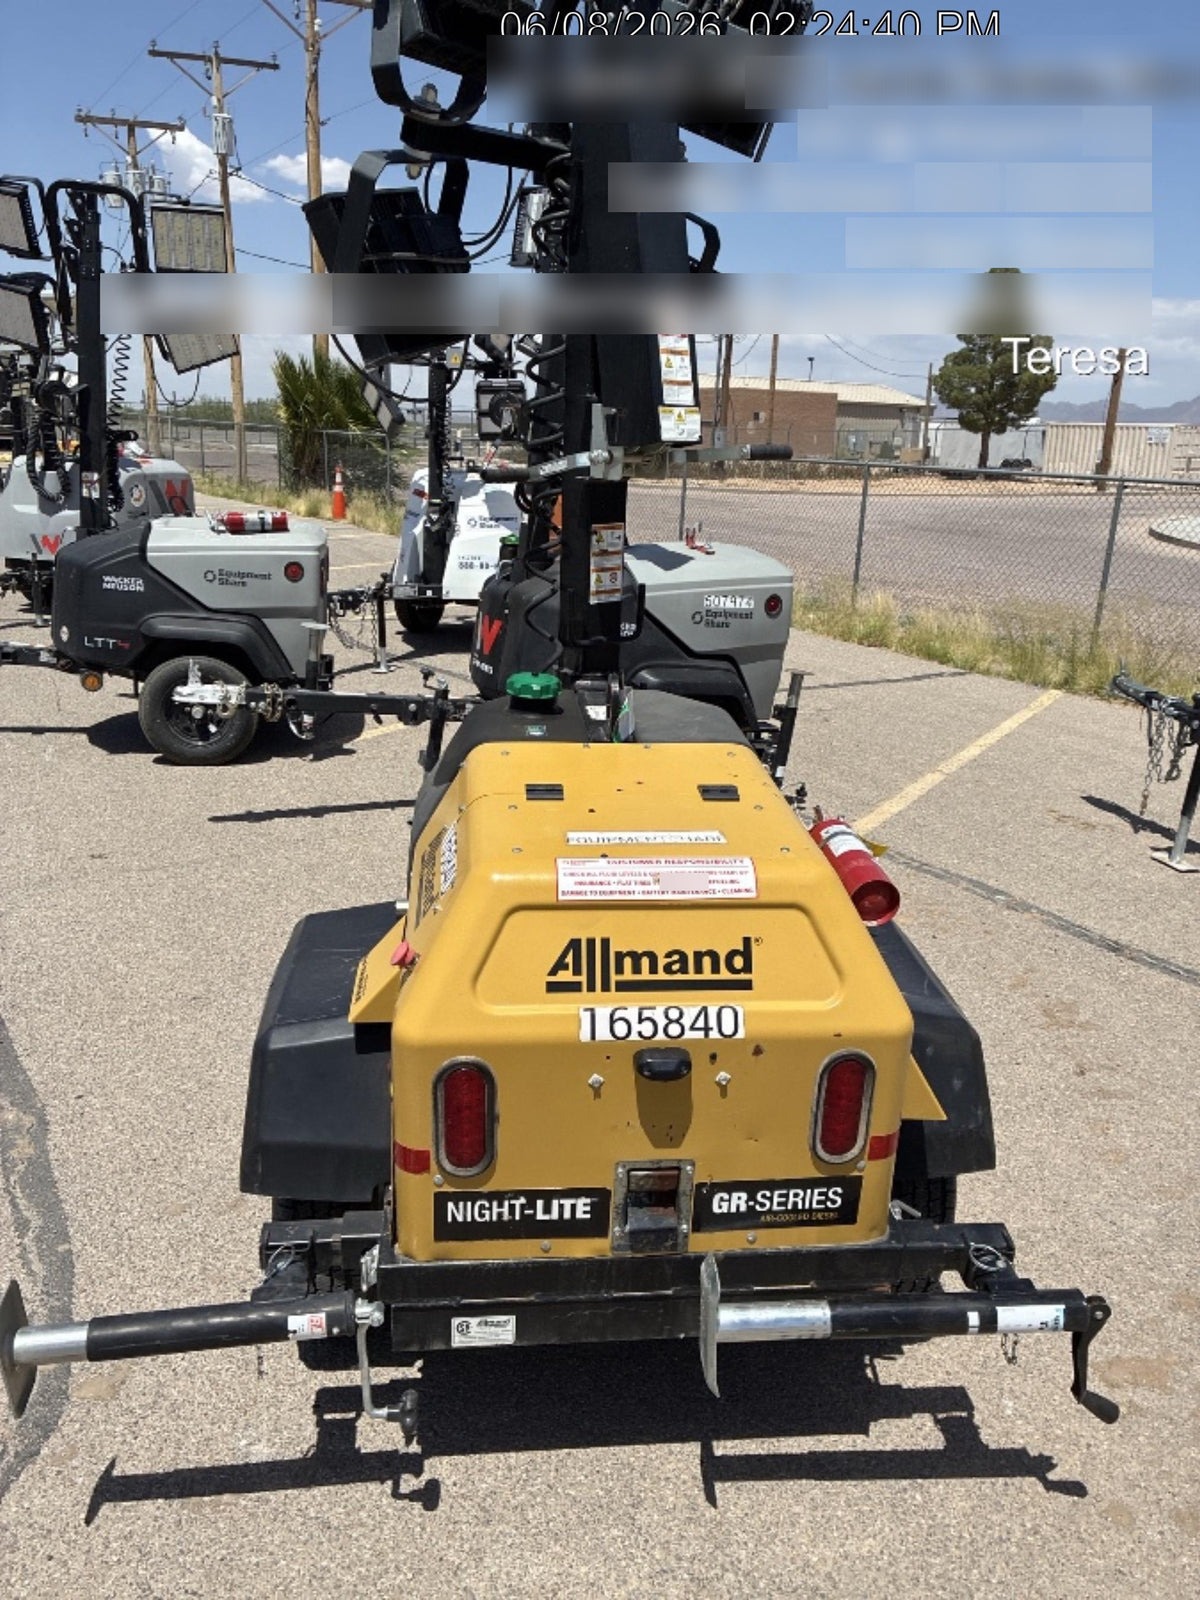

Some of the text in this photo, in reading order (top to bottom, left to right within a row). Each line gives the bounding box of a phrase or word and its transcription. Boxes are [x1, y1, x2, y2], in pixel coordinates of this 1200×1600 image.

[218, 568, 273, 581] Equipment
[218, 577, 248, 588] Share
[84, 635, 132, 651] LTT4
[546, 936, 753, 992] Allmand
[582, 1005, 740, 1041] 165840
[446, 1196, 593, 1223] NIGHT-LITE
[712, 1187, 844, 1214] GR-SERIES
